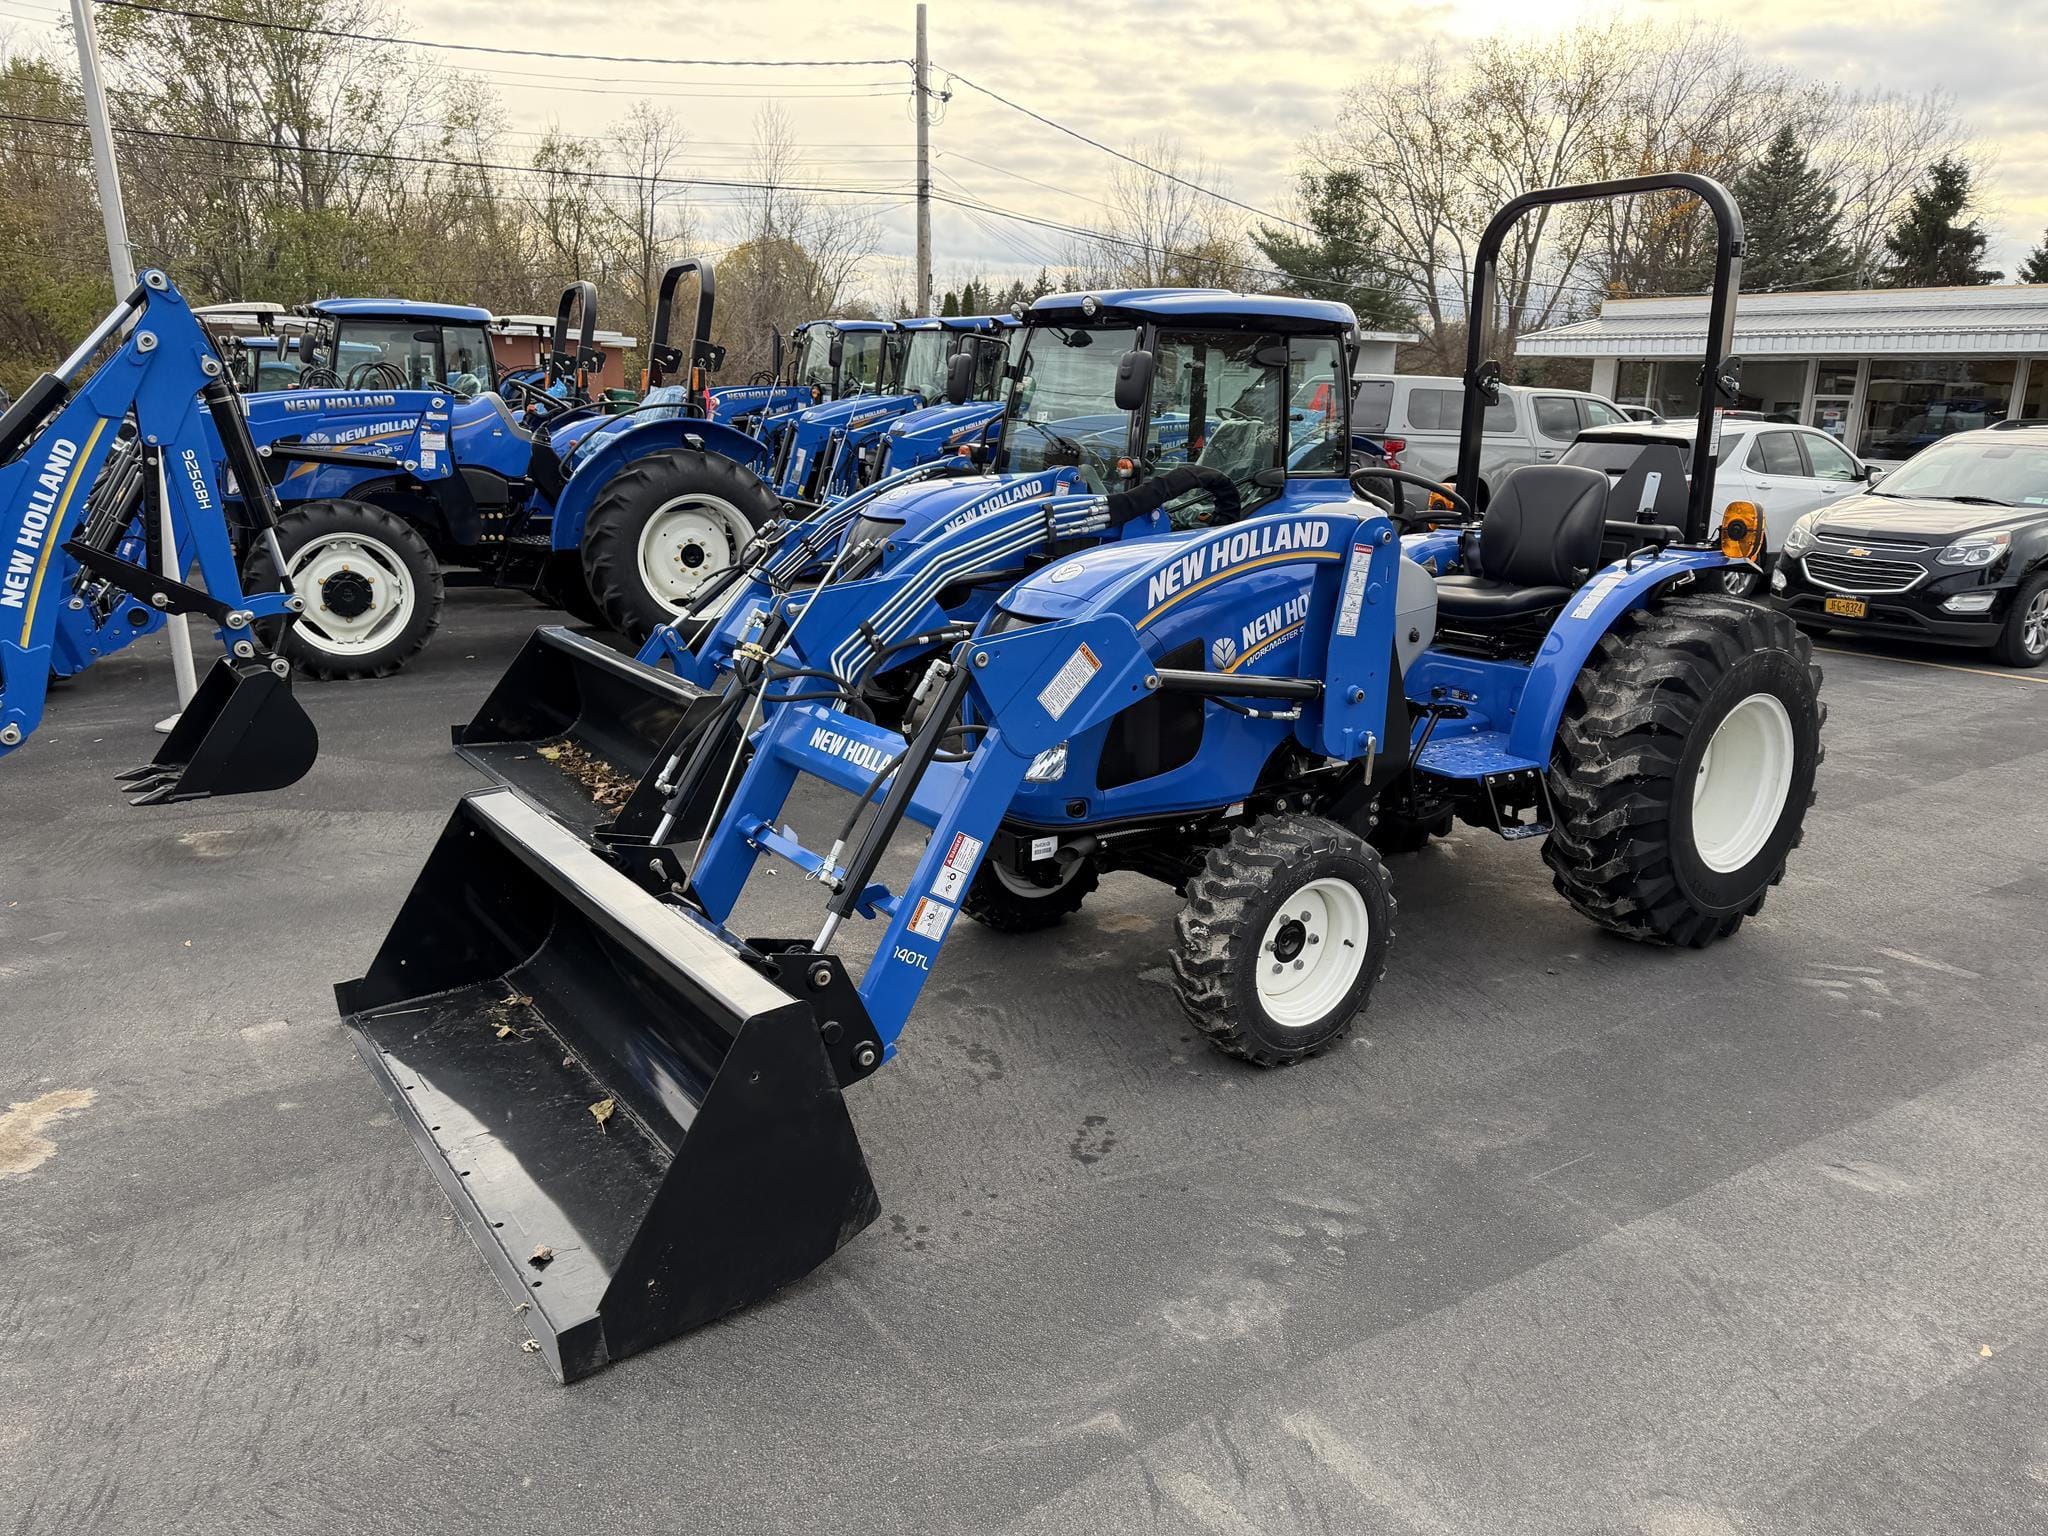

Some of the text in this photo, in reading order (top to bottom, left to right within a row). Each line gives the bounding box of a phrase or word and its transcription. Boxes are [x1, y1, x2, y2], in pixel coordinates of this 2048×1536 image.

[284, 394, 396, 412] NEW HOLLAND
[726, 391, 746, 400] NEW
[335, 418, 419, 444] NEW HOLLAN
[181, 449, 213, 510] 925GBH
[0, 438, 77, 609] NEW HOLLAND
[943, 479, 1043, 533] NEW HOLLAND
[1147, 521, 1330, 610] NEW HOLLAND
[1242, 605, 1282, 651] NEW
[1246, 629, 1299, 667] WORKMASTER
[809, 727, 848, 757] NEW
[893, 945, 929, 971] 140TL
